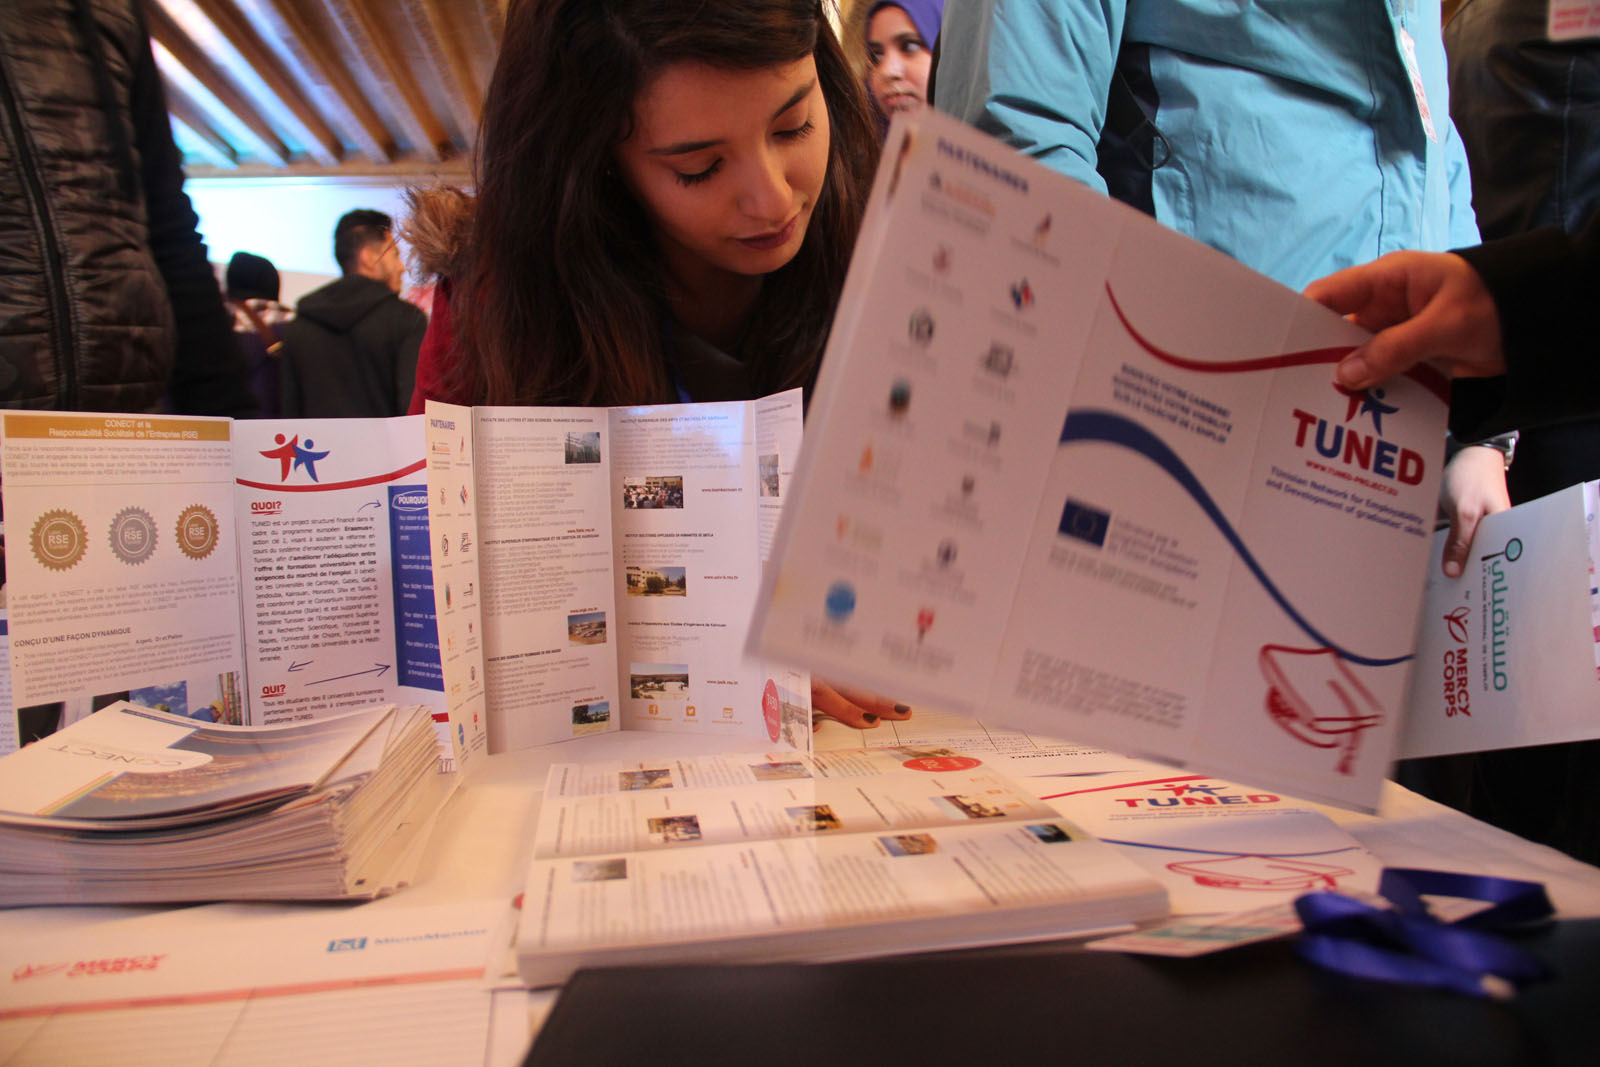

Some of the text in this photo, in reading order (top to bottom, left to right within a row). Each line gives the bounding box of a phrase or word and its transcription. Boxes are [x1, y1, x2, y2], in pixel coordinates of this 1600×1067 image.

[105, 419, 135, 428] CONECT
[49, 428, 102, 438] Responsabilité
[104, 429, 134, 438] Sociétale
[146, 431, 180, 439] l'Entreprise
[182, 431, 198, 440] (RSE)
[1292, 408, 1424, 486] TUNED
[1266, 478, 1282, 490] and
[1284, 483, 1343, 508] Development
[1345, 504, 1354, 513] of
[1272, 465, 1424, 525] Tunisian Network for Employability
[251, 501, 282, 511] QUOI?
[124, 530, 142, 540] RSE
[189, 527, 205, 536] RSE
[48, 534, 69, 545] RSE
[255, 573, 285, 582] exigences
[1488, 560, 1509, 691] مستقبلي
[14, 627, 131, 648] CONÇU D'UNE FAÇON DYNAMIQUE
[262, 684, 286, 694] QUI?
[1443, 650, 1458, 718] CORPS
[1456, 648, 1472, 717] MERCY
[48, 745, 182, 766] CONECT
[1115, 794, 1281, 807] TUNED
